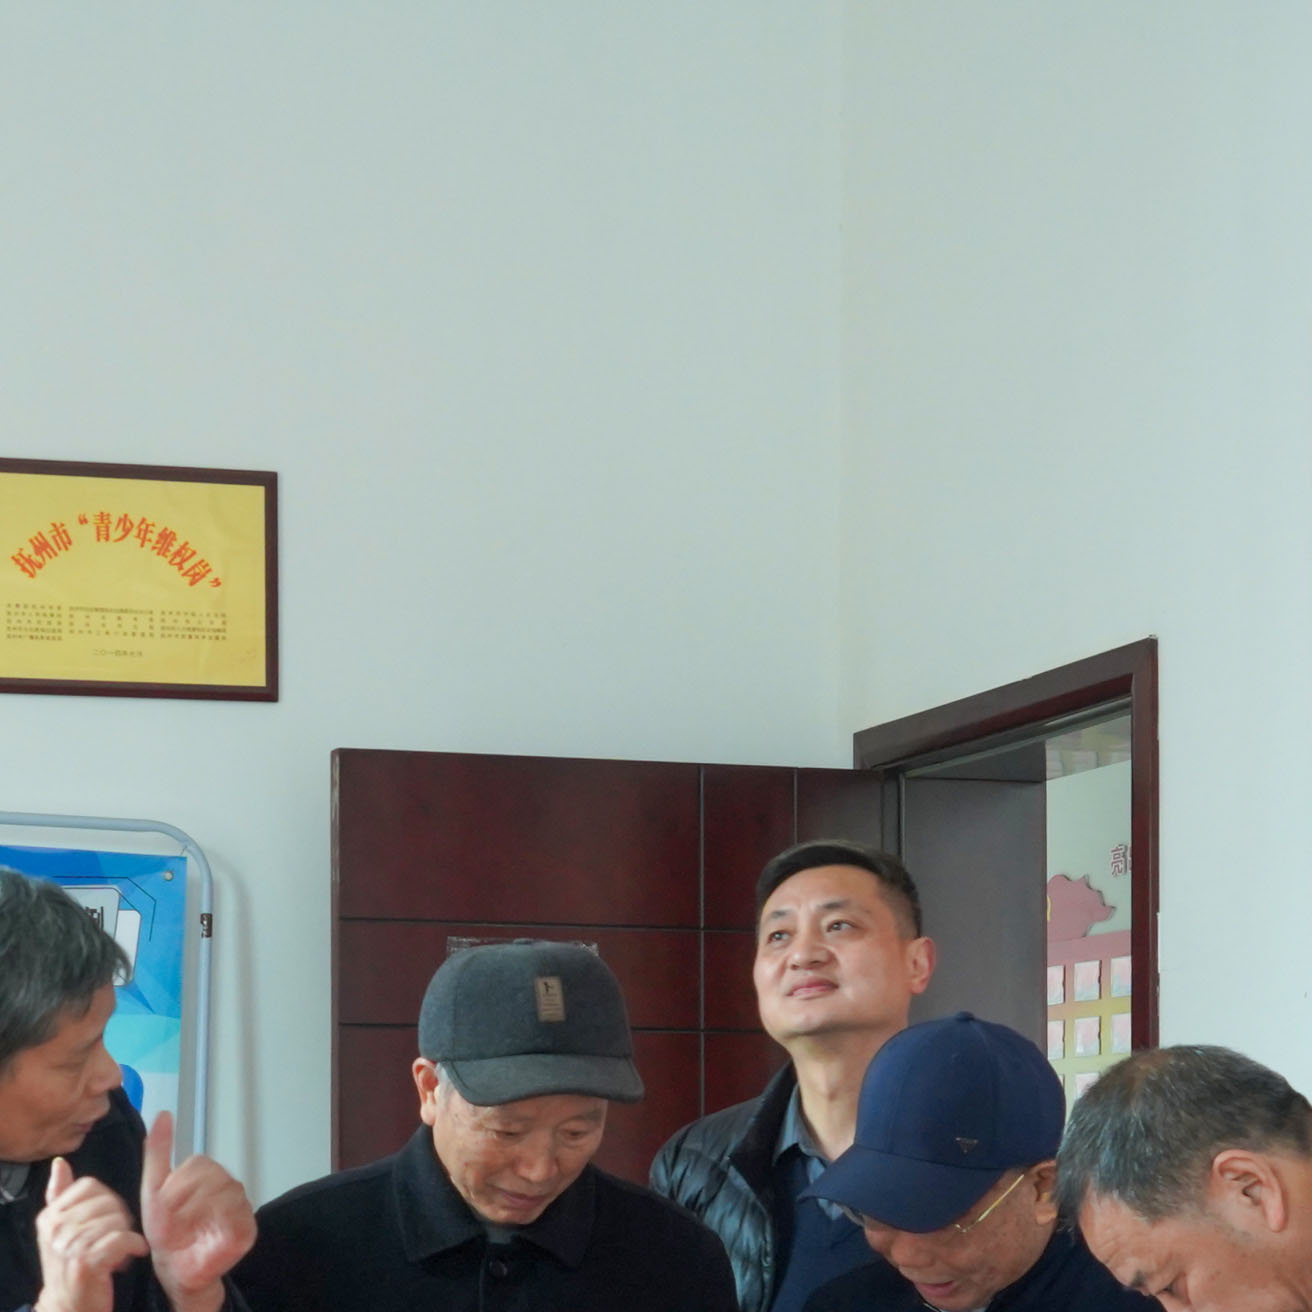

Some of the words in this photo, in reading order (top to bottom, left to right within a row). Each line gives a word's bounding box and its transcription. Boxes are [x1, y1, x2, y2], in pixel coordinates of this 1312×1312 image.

[11, 511, 223, 588] 抚州市“青少年维权岗”
